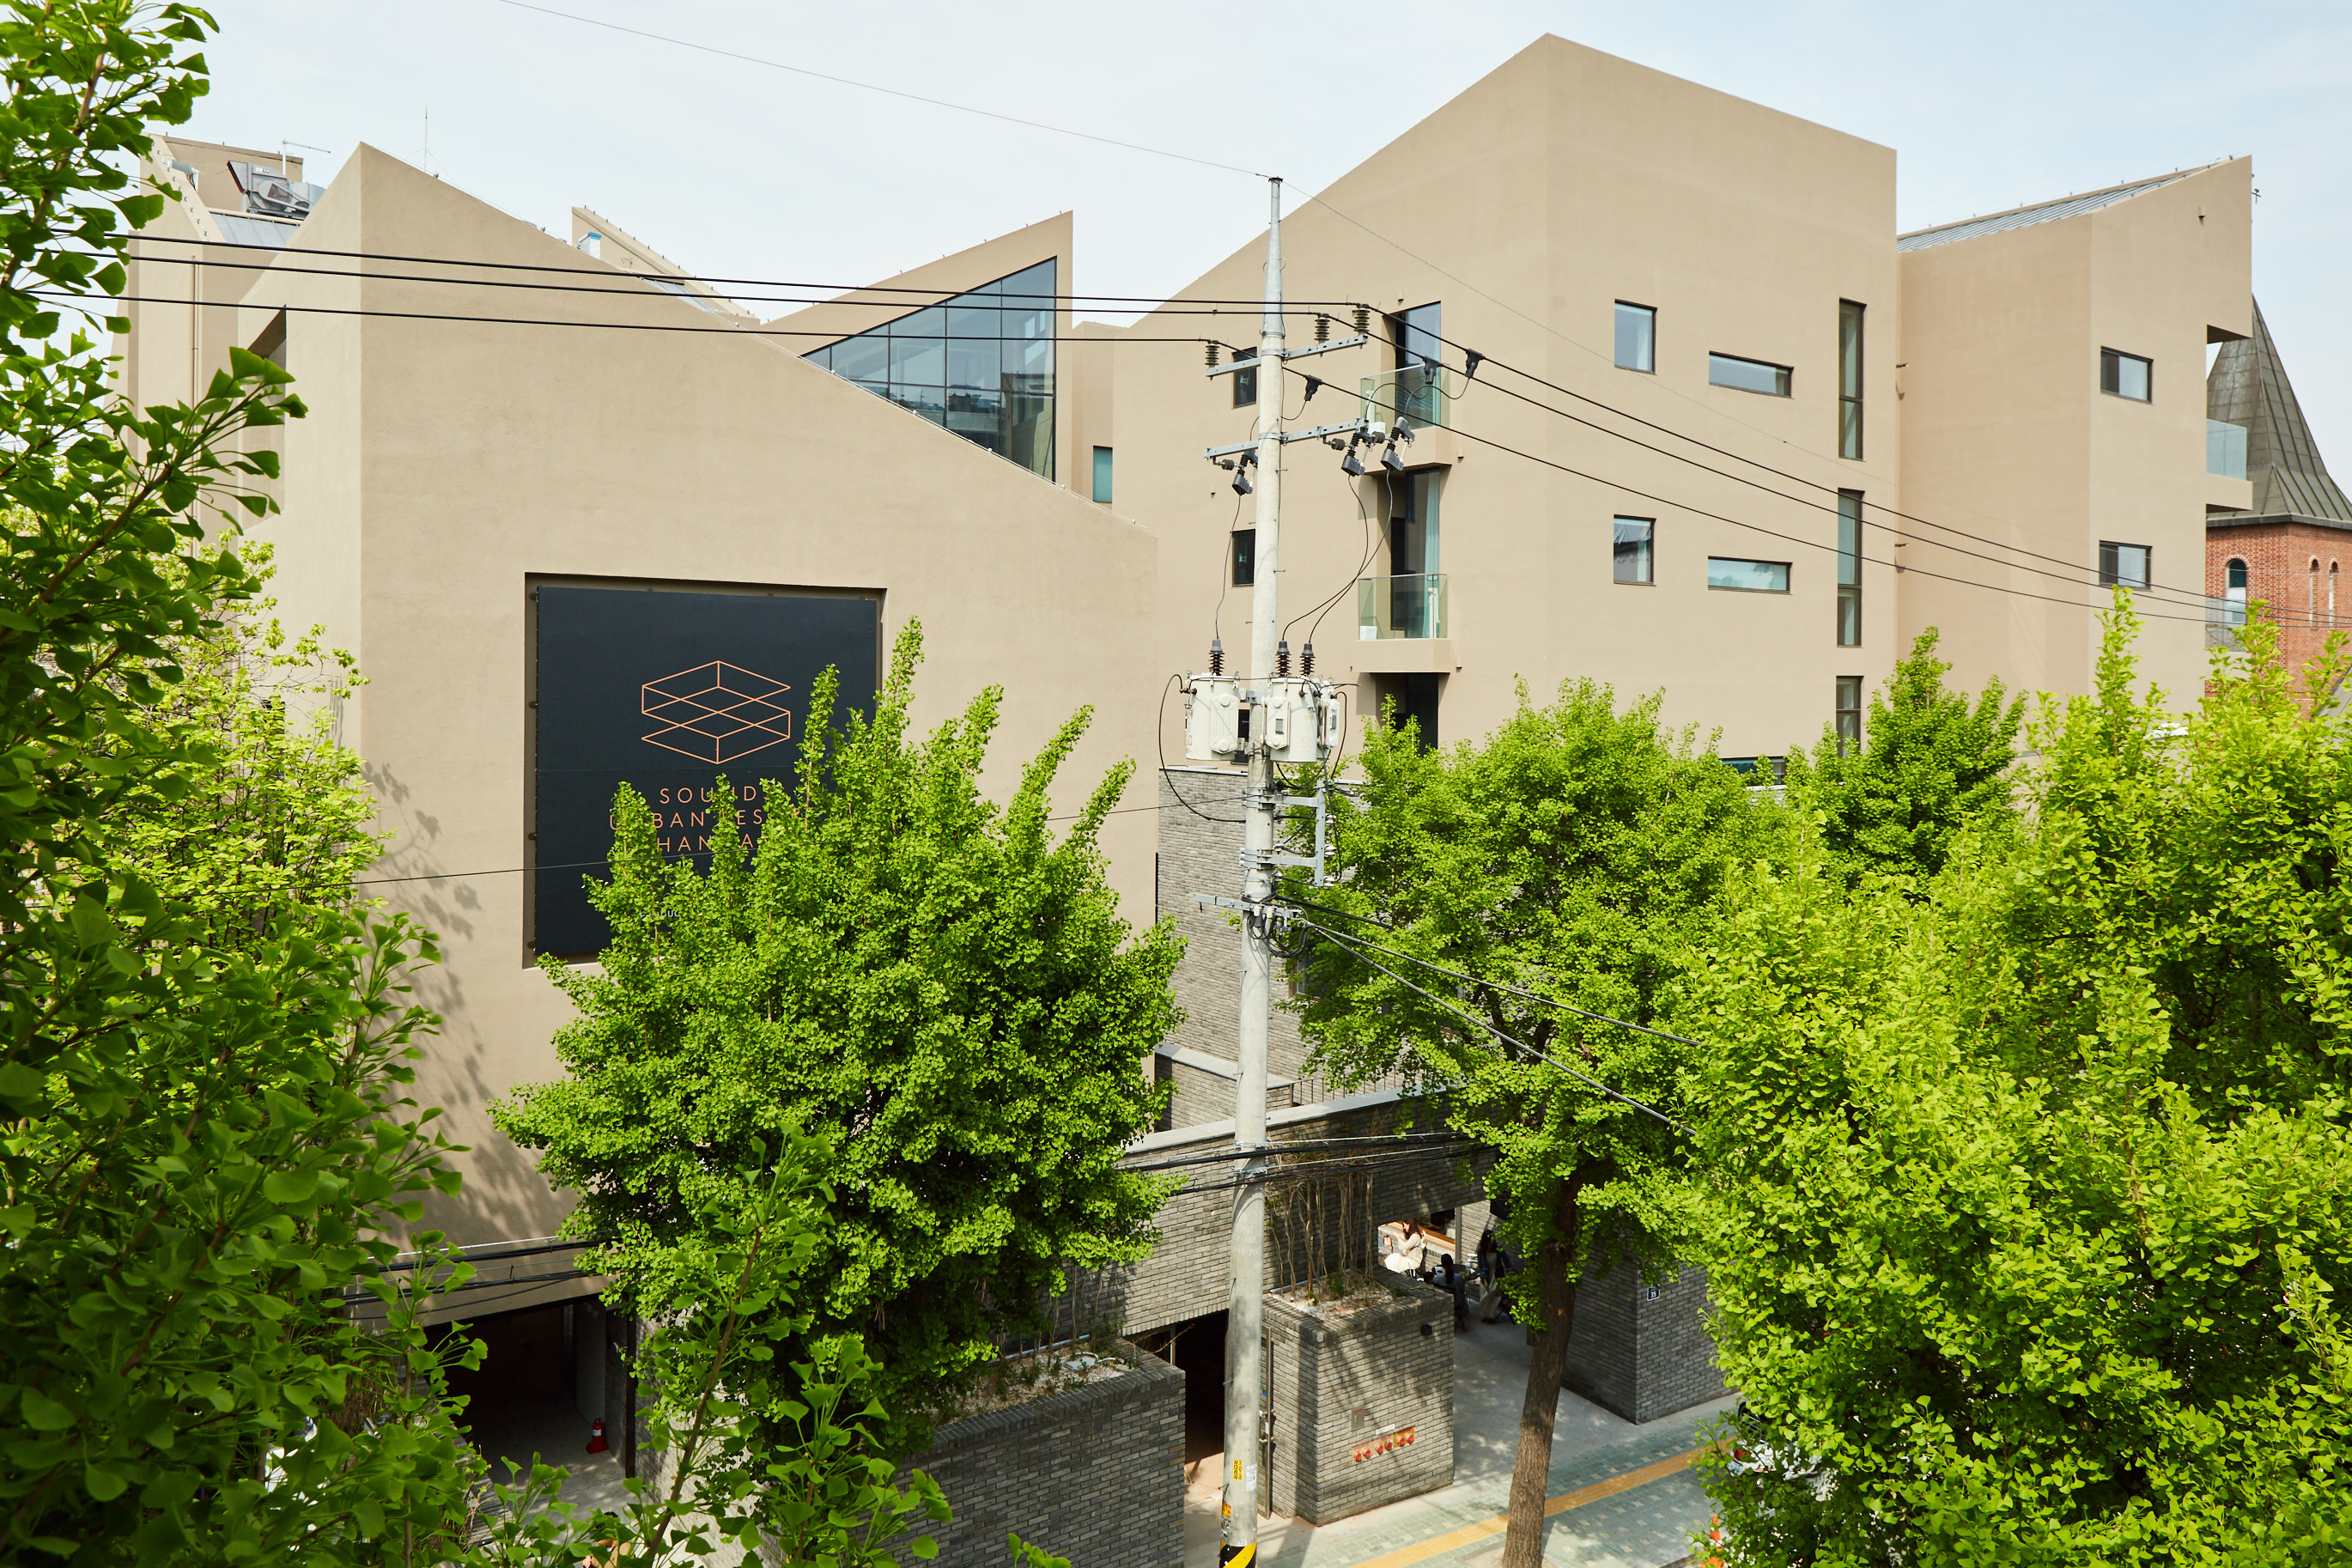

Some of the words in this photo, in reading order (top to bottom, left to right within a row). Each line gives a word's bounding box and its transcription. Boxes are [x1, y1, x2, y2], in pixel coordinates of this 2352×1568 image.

[659, 785, 771, 805] SOUD
[610, 811, 704, 830] UBAN
[657, 833, 767, 853] HANA
